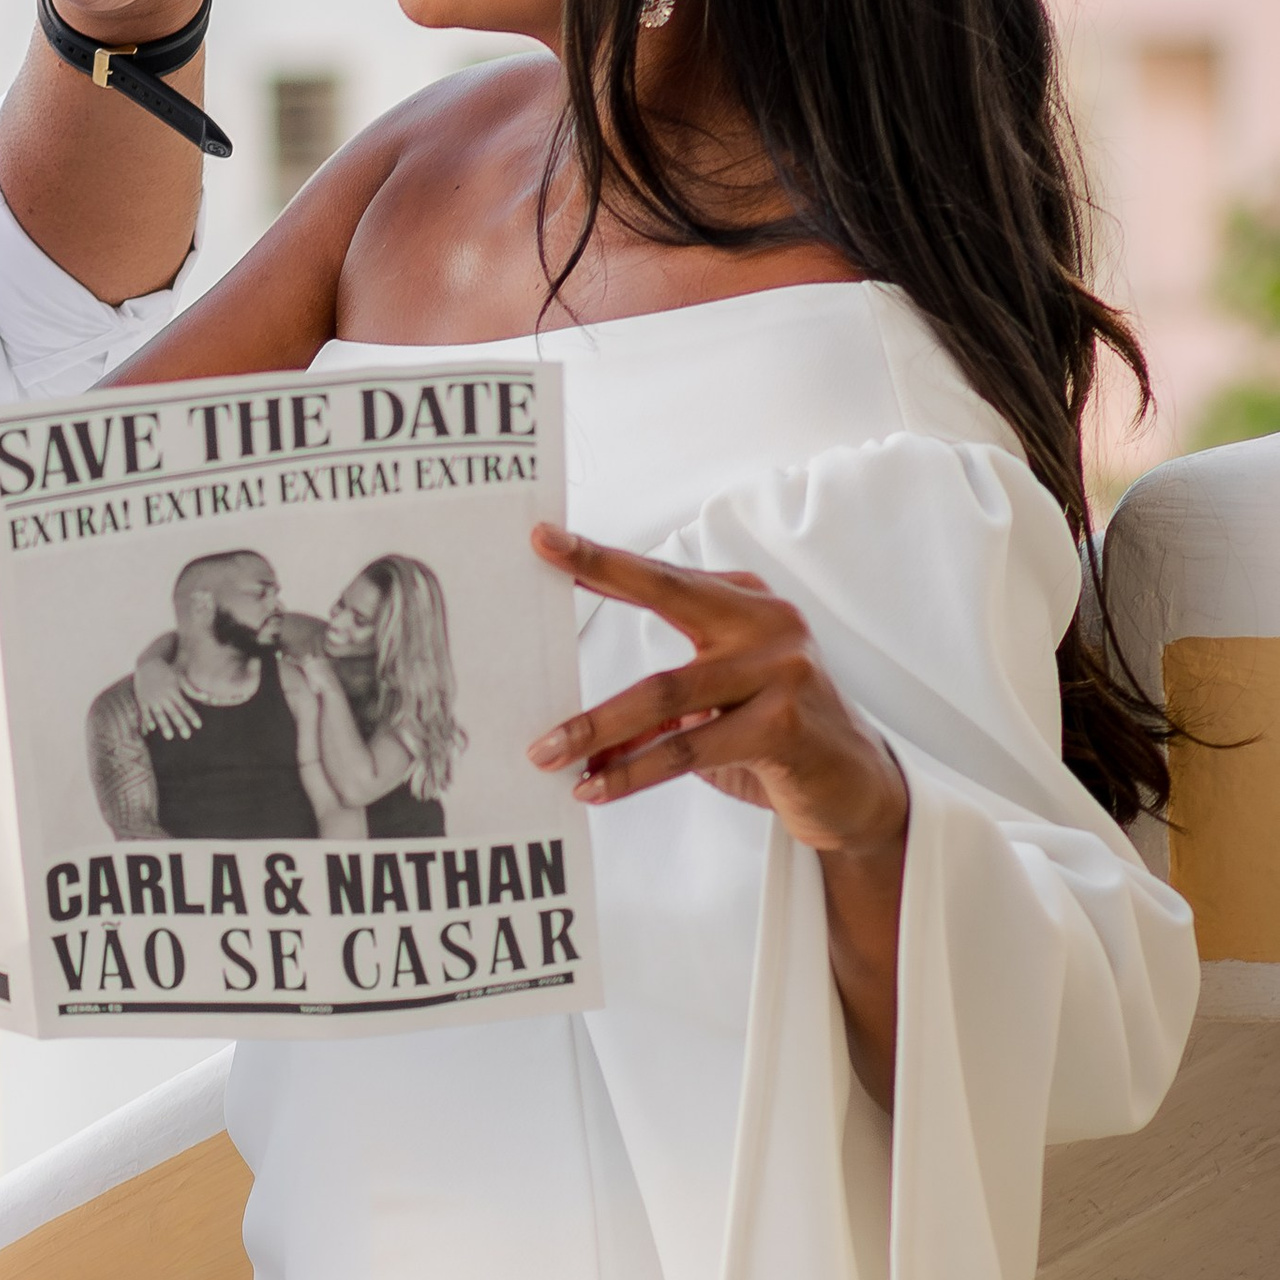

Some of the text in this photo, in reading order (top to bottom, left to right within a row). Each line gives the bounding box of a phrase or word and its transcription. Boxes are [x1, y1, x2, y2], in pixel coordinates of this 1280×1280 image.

[188, 392, 331, 463] THE
[362, 381, 536, 444] DATE
[9, 454, 538, 551] EXTRA! EXTRA! EXTRA! EXTRA!
[46, 838, 567, 922] CARLA & NATHAN
[52, 907, 581, 993] VÃO SE CASAR
